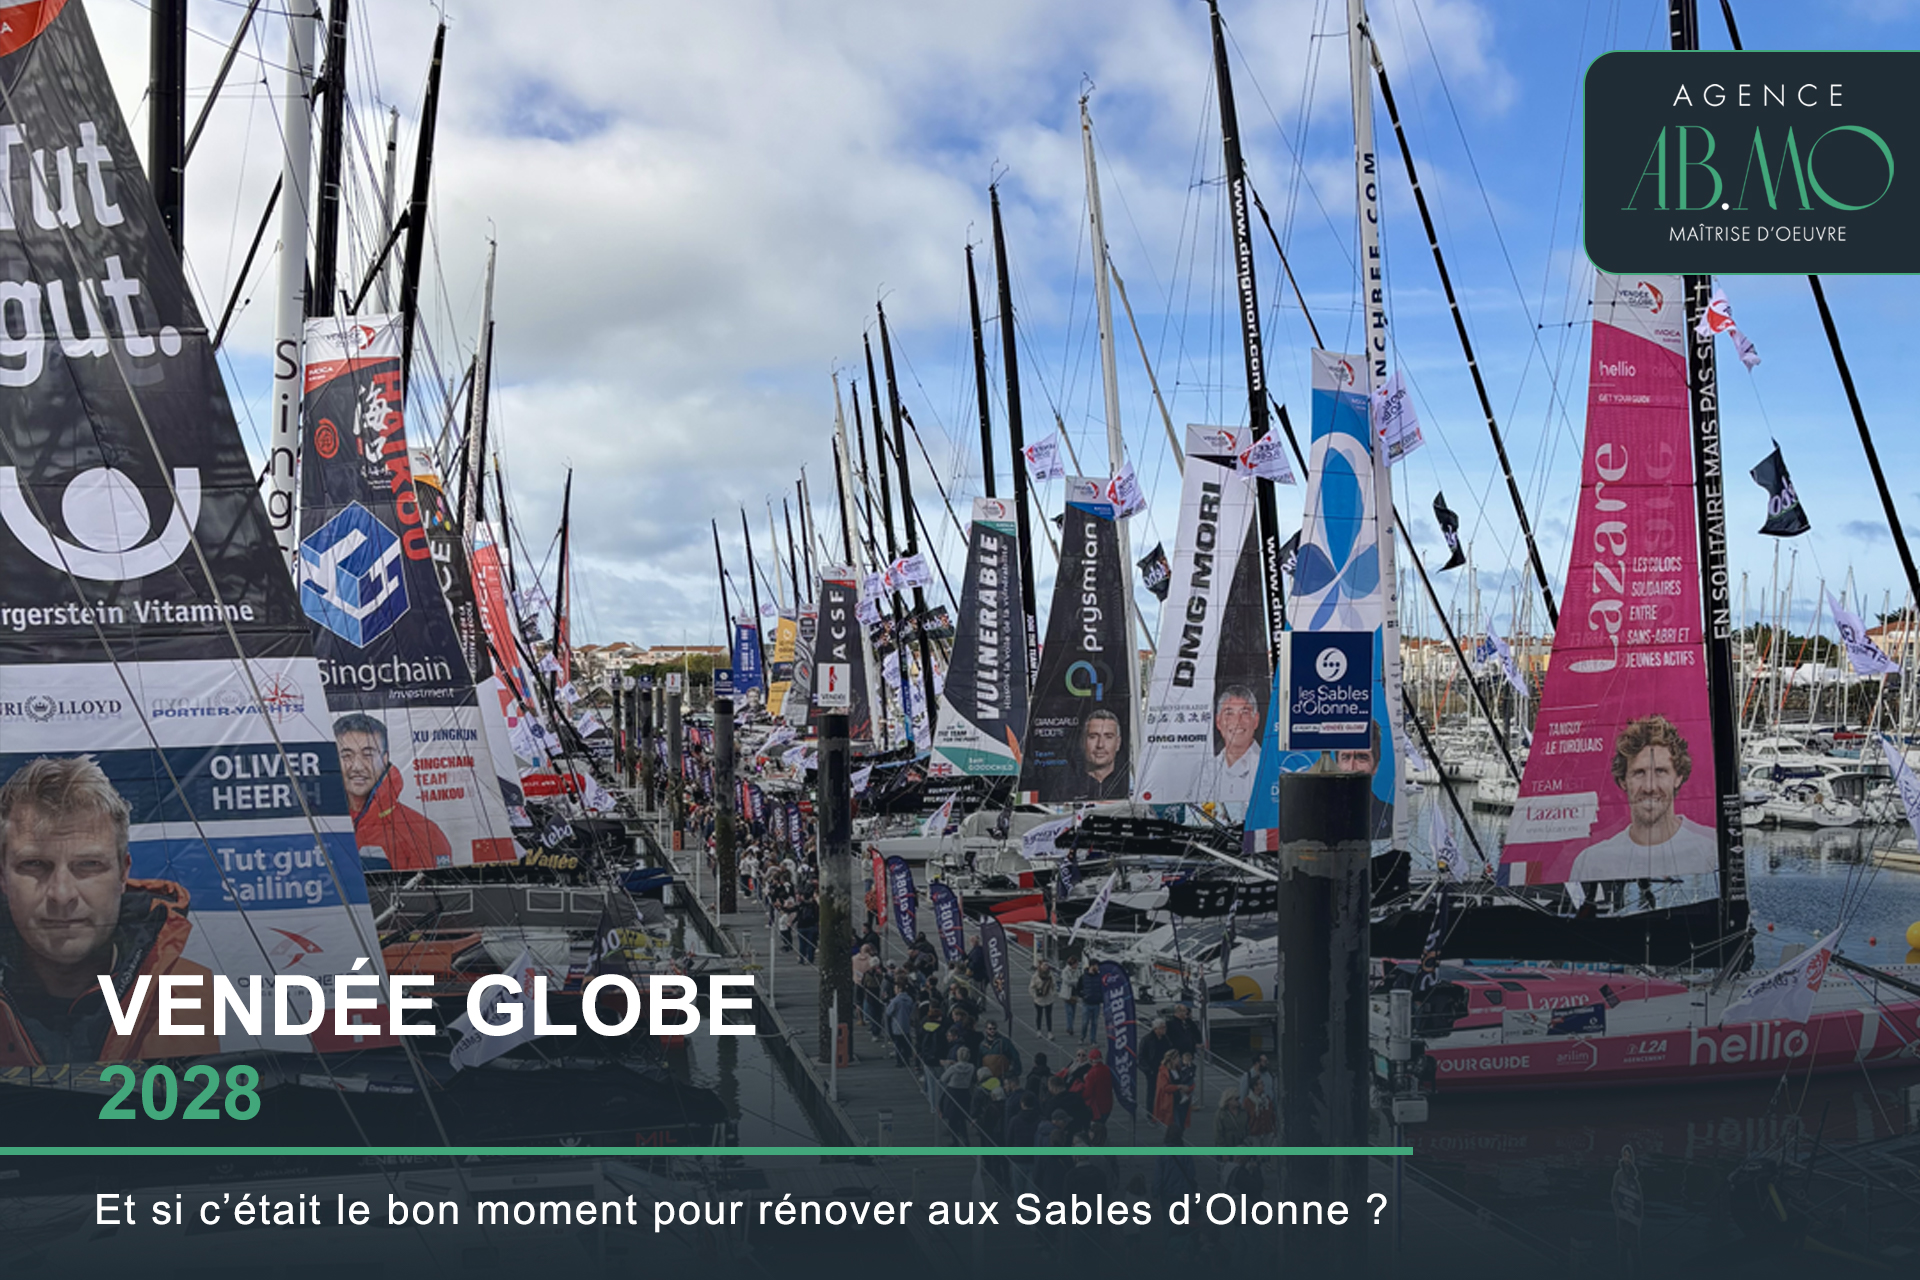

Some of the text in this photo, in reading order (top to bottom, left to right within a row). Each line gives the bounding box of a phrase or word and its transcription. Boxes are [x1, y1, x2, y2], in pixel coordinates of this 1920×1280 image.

[0, 255, 182, 387] gut.
[1600, 360, 1636, 377] hellio
[1698, 368, 1717, 413] PAS
[1701, 420, 1721, 477] MAIS
[373, 369, 432, 561] HAIKOU
[1705, 484, 1730, 602] SOLITAIRE
[1568, 443, 1629, 673] Lazare
[1632, 558, 1647, 573] LES
[1082, 522, 1104, 652] prysmian
[1172, 481, 1221, 689] DMG MORI
[1631, 580, 1681, 597] SOLIDAIRES
[137, 600, 254, 626] Vitamine
[1629, 605, 1658, 621] ENTRE
[1714, 604, 1731, 640] EN
[829, 591, 849, 660] ACSF
[976, 533, 999, 720] VULNERABLE
[1627, 627, 1690, 645] SANS-ABRI ET
[1625, 650, 1695, 668] JEUNES ACTIFS
[319, 655, 453, 691] Singchain
[1298, 685, 1369, 701] les Sables
[58, 699, 122, 717] LLOYD
[152, 704, 305, 719] PORTIER-YACHTS
[1034, 716, 1079, 726] GIANCARLO
[1548, 721, 1581, 736] TANGUY
[412, 730, 429, 743] XU
[1148, 734, 1207, 743] DMG MORI
[1545, 741, 1556, 755] LE
[210, 752, 321, 780] OLIVER
[412, 755, 475, 771] SINGCHAIN
[413, 774, 447, 786] TEAM
[1531, 780, 1562, 792] TEAM
[212, 783, 291, 811] HEER
[1526, 805, 1579, 821] Lazare
[217, 847, 266, 872] Tut
[525, 846, 579, 870] Vallée
[222, 874, 324, 904] Sailing
[1639, 1039, 1668, 1053] L2A
[1689, 1022, 1809, 1066] hellio
[1556, 1050, 1590, 1063] arilim
